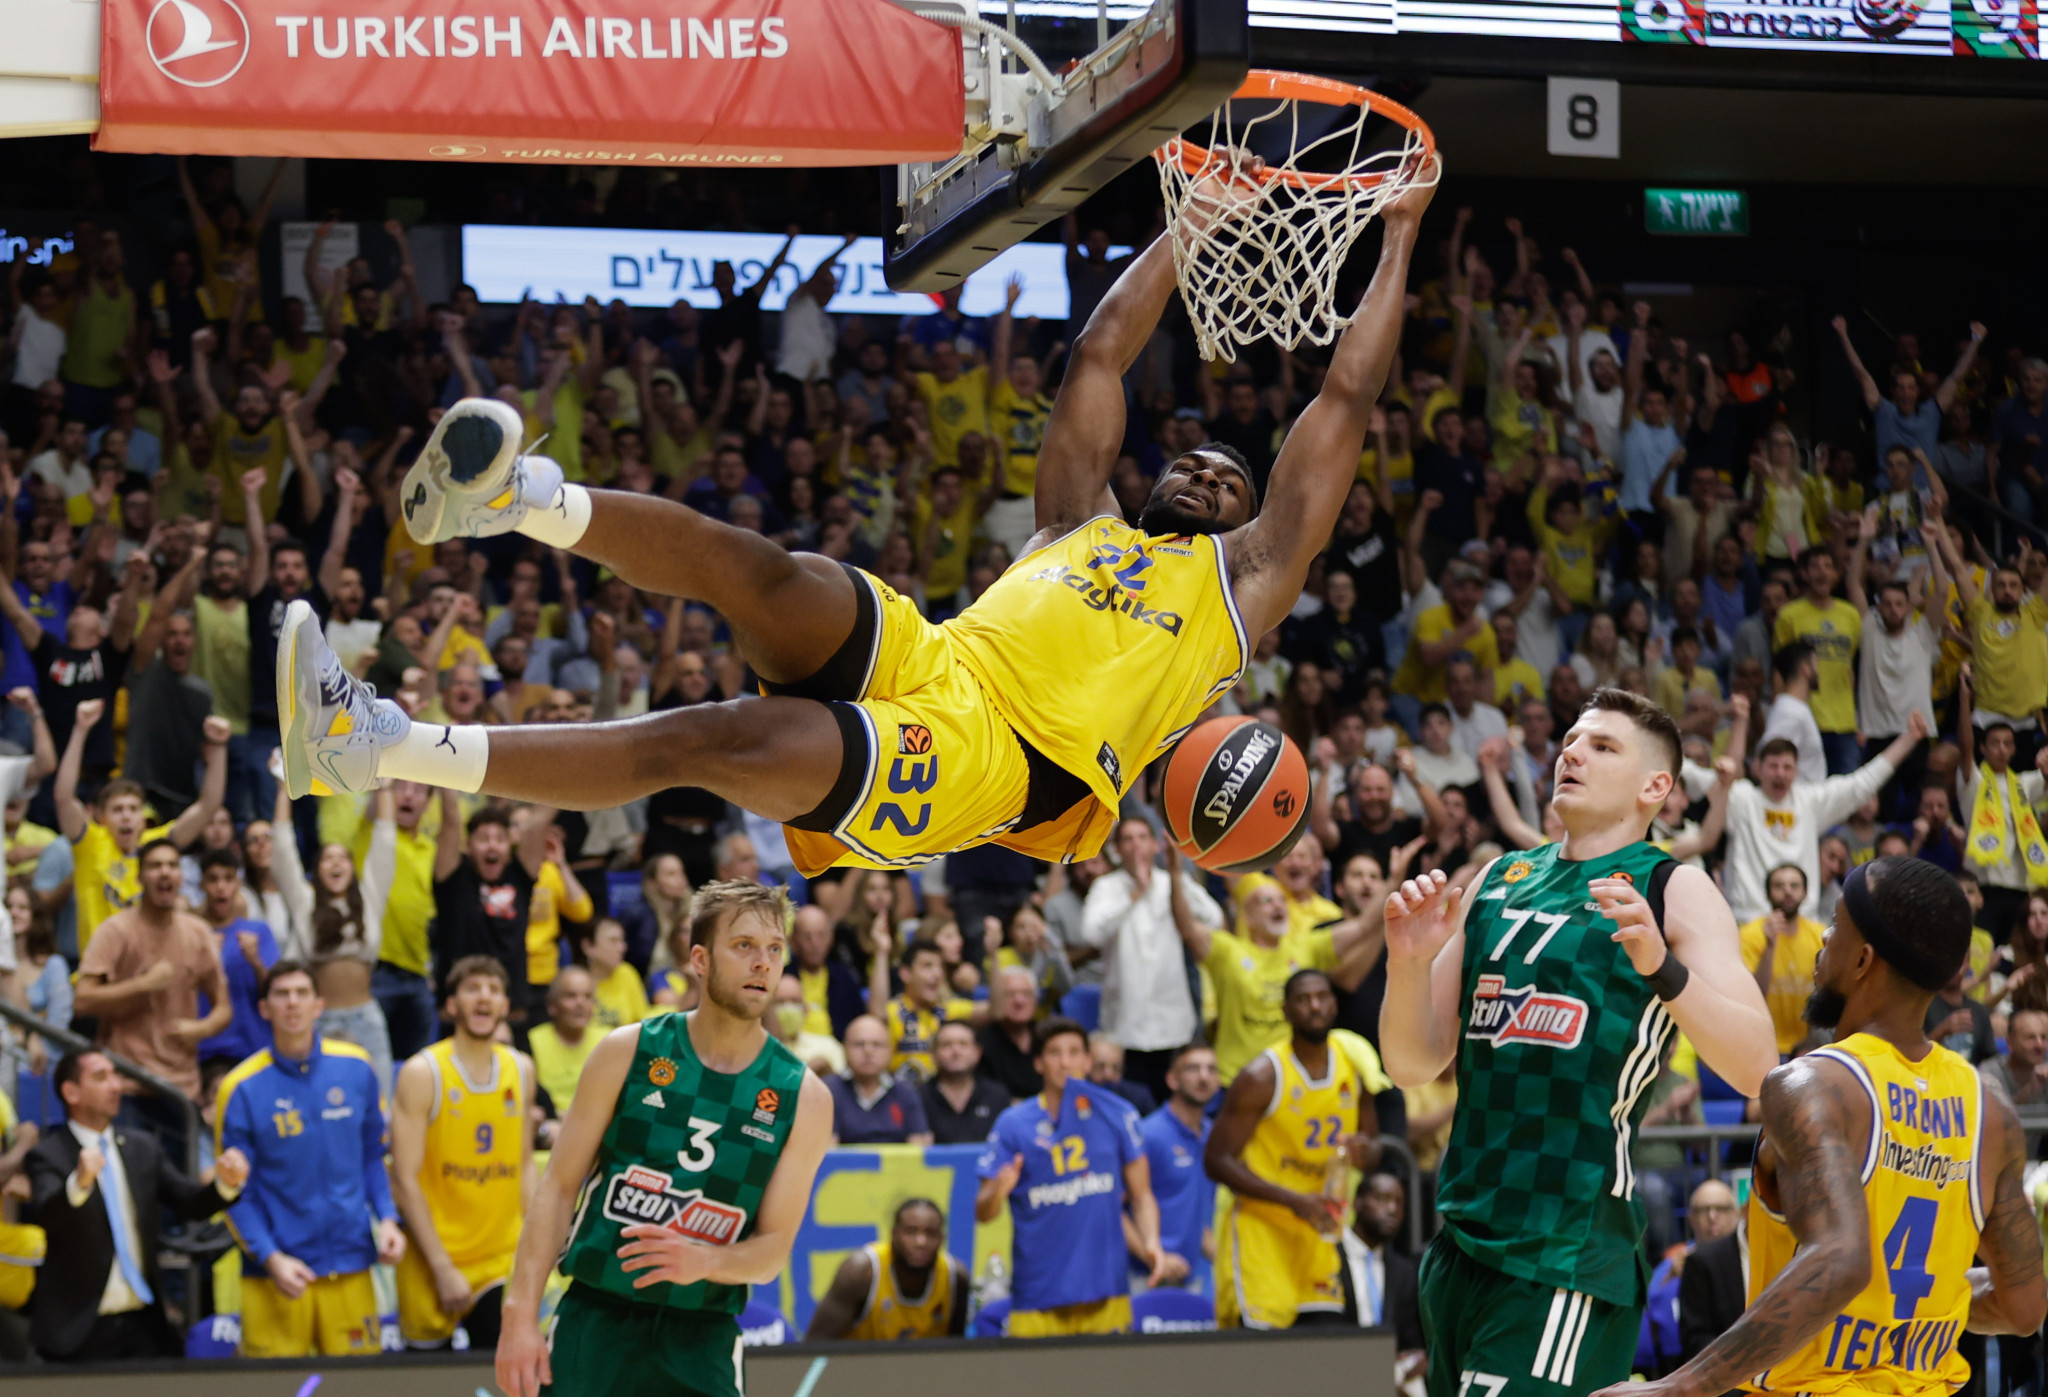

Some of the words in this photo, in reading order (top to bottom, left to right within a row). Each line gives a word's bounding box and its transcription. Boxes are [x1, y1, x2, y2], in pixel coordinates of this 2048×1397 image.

[275, 15, 522, 59] TURKISH
[542, 16, 789, 60] AIRLINES
[1567, 94, 1599, 141] 8
[502, 149, 637, 162] TURKISH
[645, 151, 784, 163] AIRLINES
[870, 754, 938, 837] 32
[1203, 728, 1278, 828] SPALDING
[1489, 908, 1572, 965] 77
[273, 1110, 304, 1138] 15
[474, 1122, 493, 1154] 9
[677, 1116, 722, 1172] 3
[1305, 1115, 1343, 1149] 22
[1051, 1134, 1089, 1176] 12
[1028, 1171, 1114, 1210] Playtika
[1883, 1196, 1939, 1320] 4
